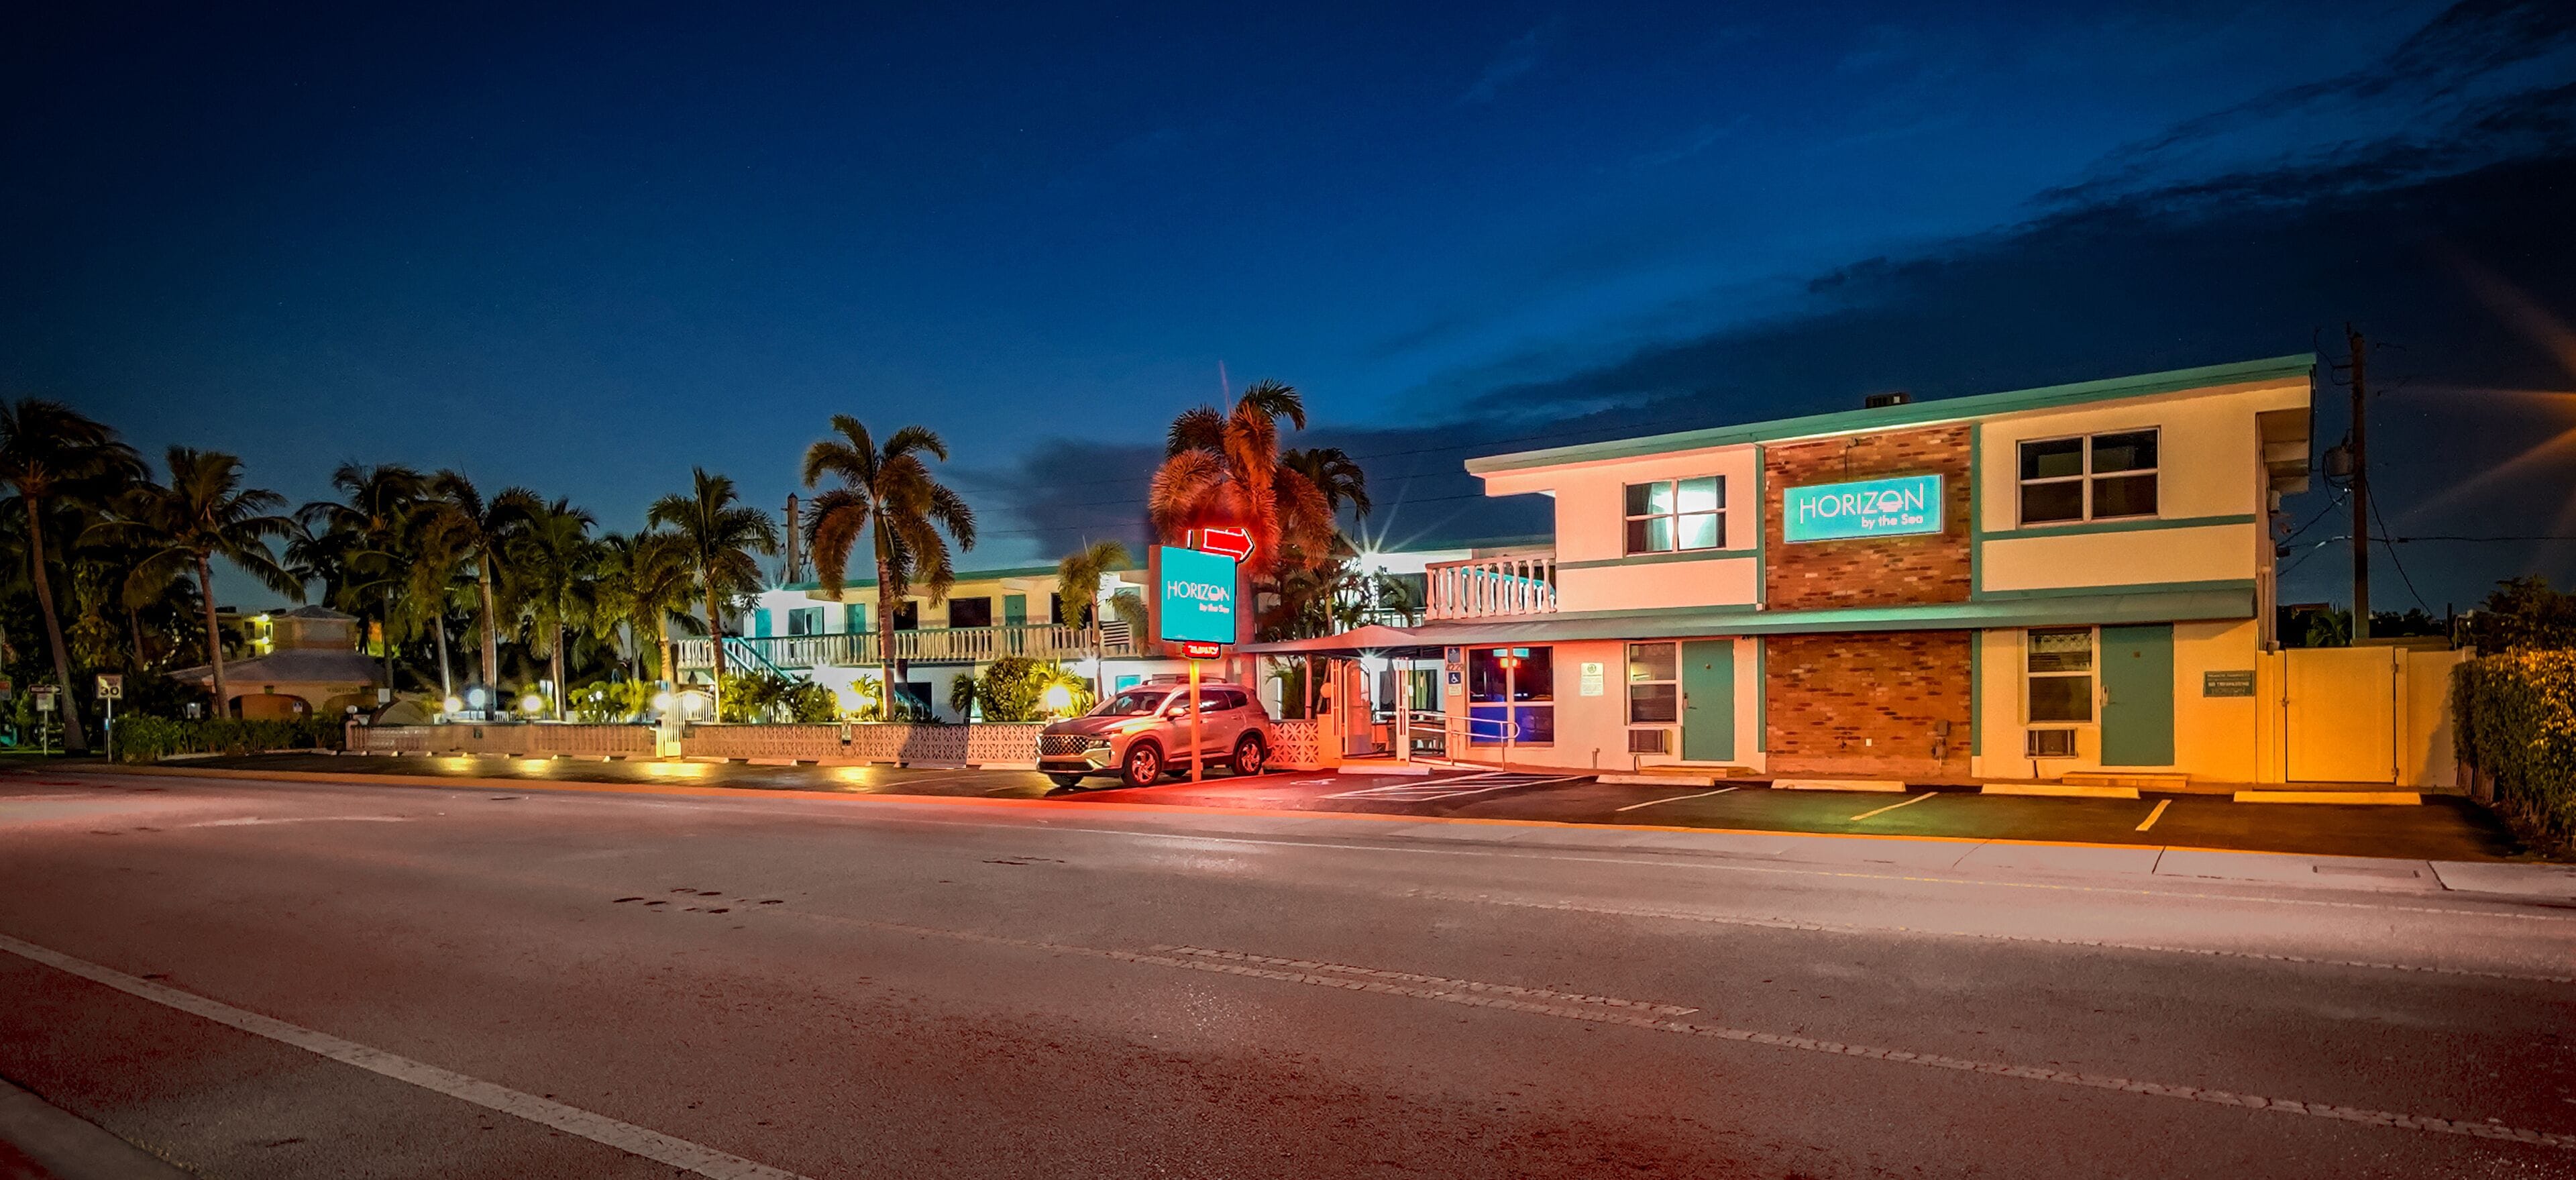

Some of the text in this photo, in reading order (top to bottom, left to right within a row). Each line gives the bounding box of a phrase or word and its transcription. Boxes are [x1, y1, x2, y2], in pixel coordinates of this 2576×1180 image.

[1800, 482, 1924, 524] HORIZON
[1861, 513, 1924, 531] by the Sea
[1167, 580, 1230, 601] HORIZON
[101, 686, 119, 696] 30
